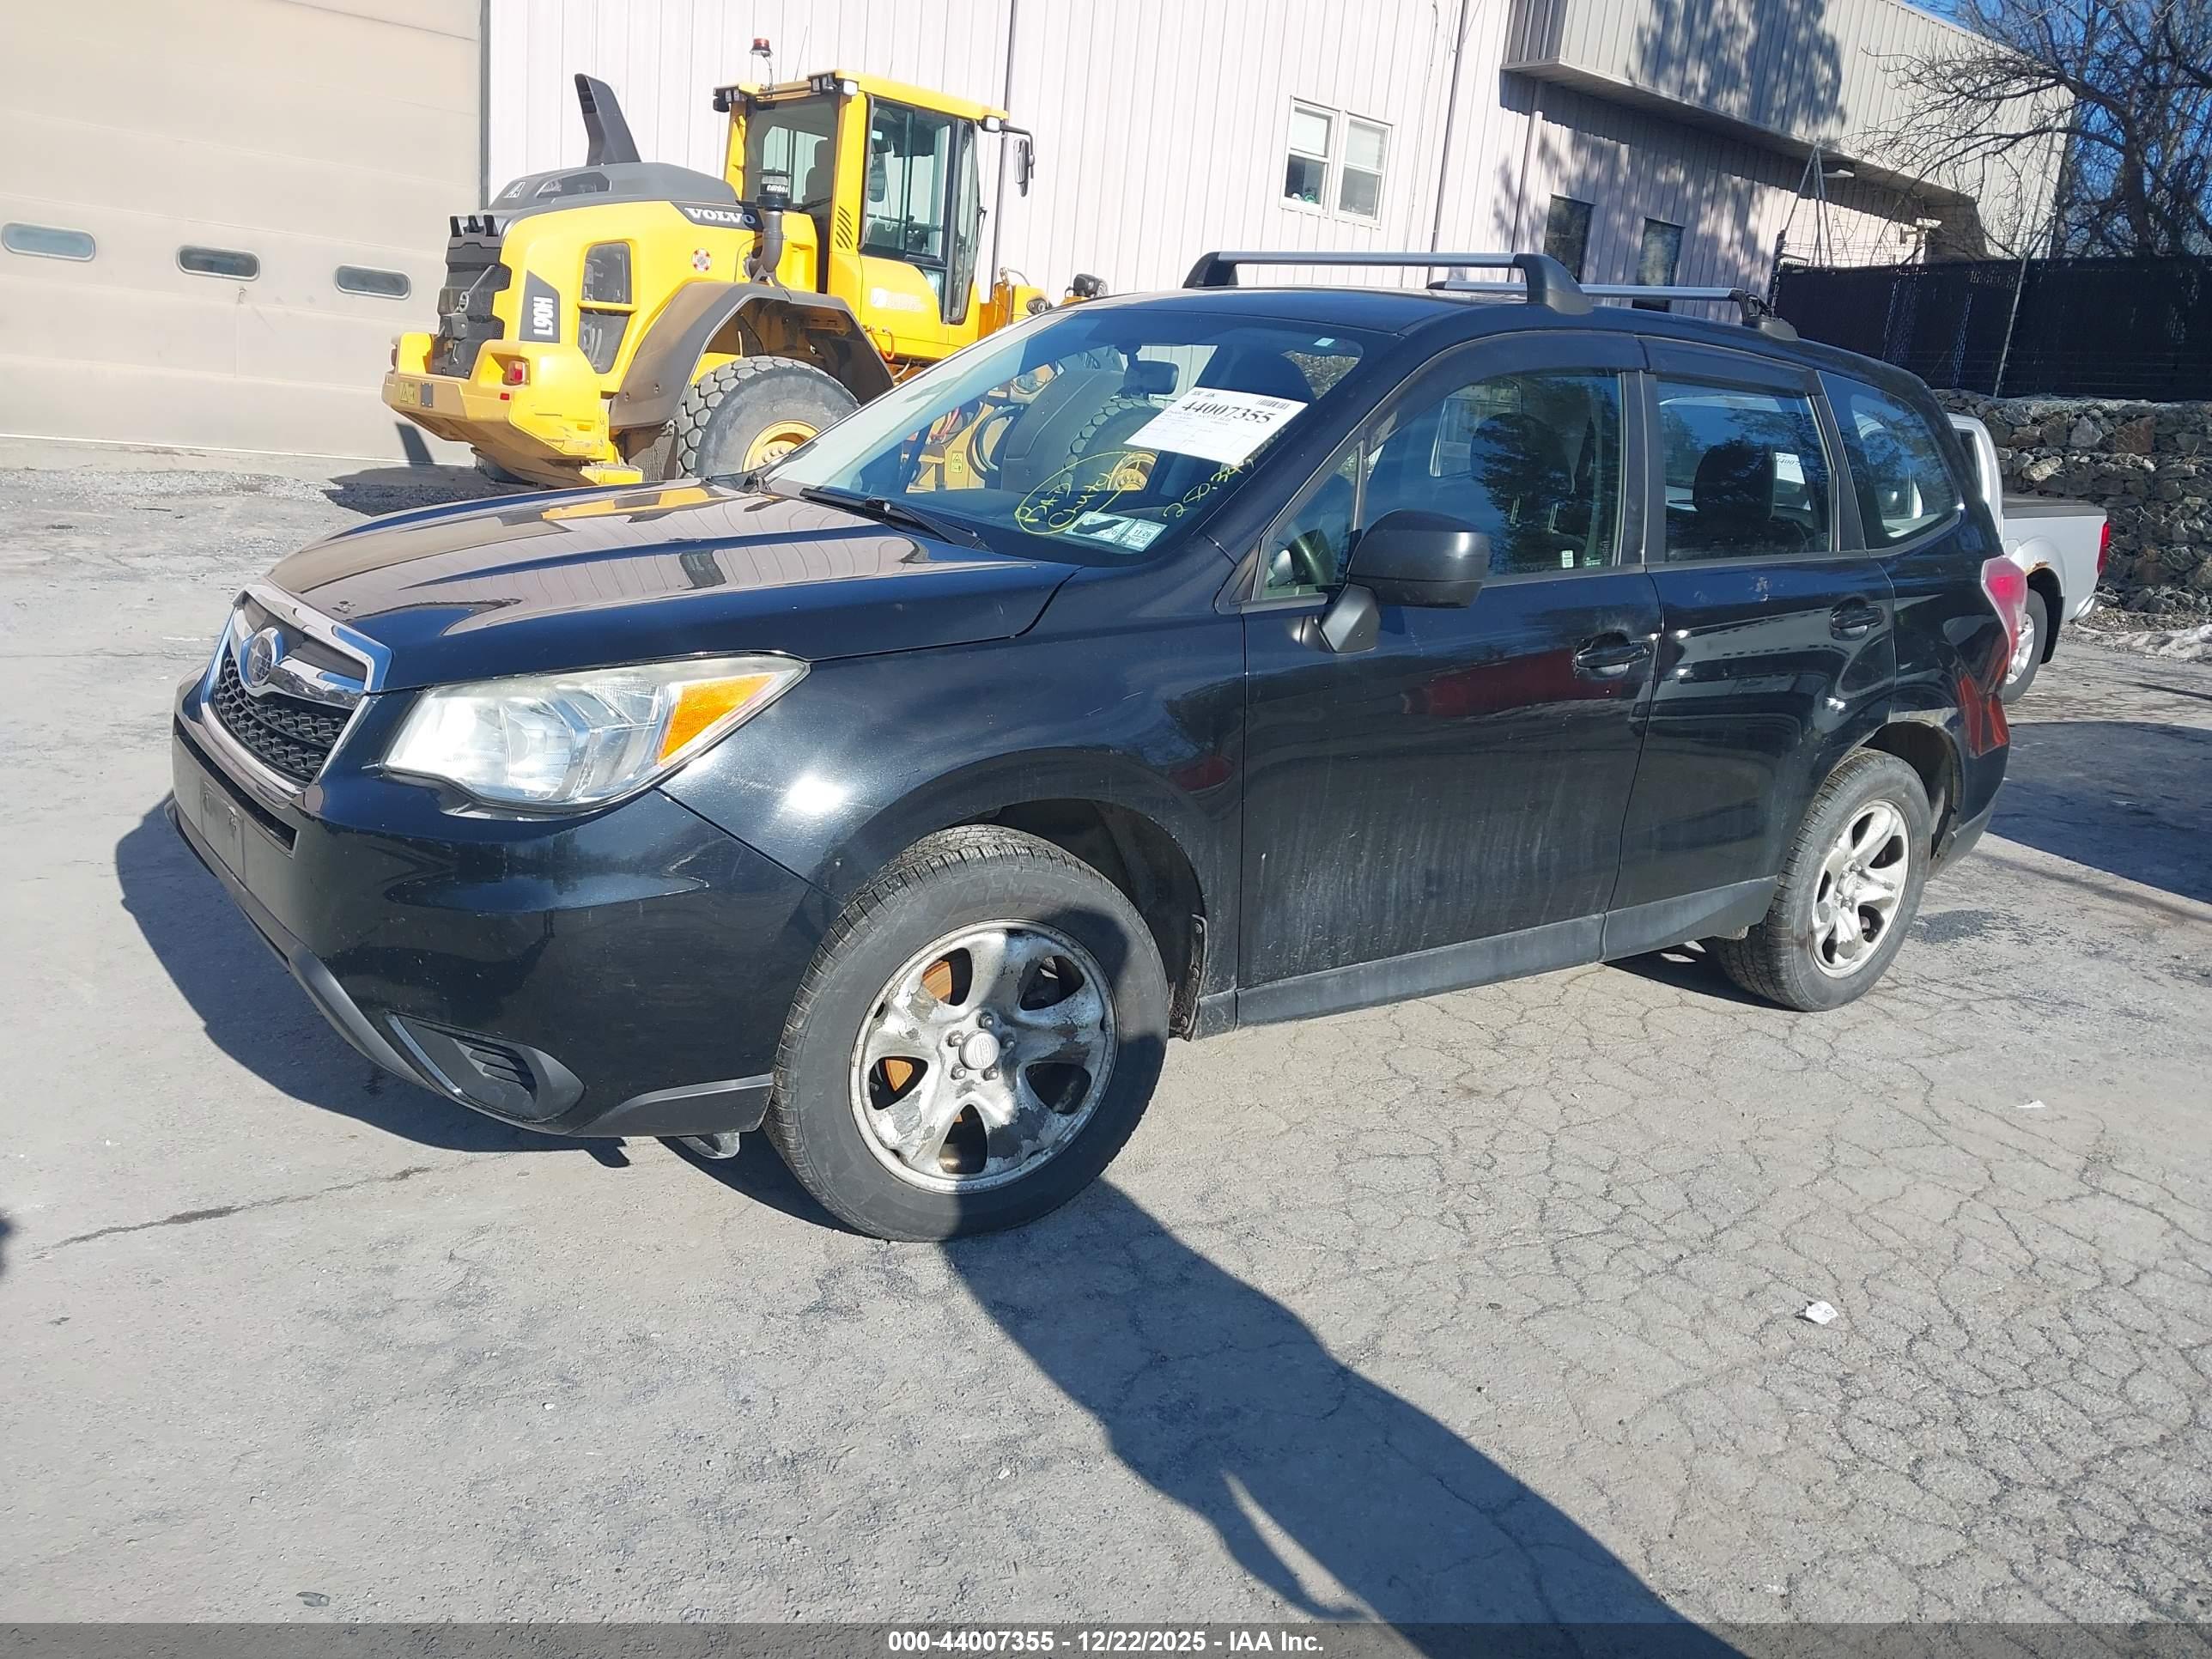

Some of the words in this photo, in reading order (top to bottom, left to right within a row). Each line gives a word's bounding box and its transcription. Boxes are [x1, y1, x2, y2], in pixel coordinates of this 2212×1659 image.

[684, 207, 756, 224] VOLVO
[533, 296, 554, 336] L90H
[1182, 400, 1277, 424] 44007355
